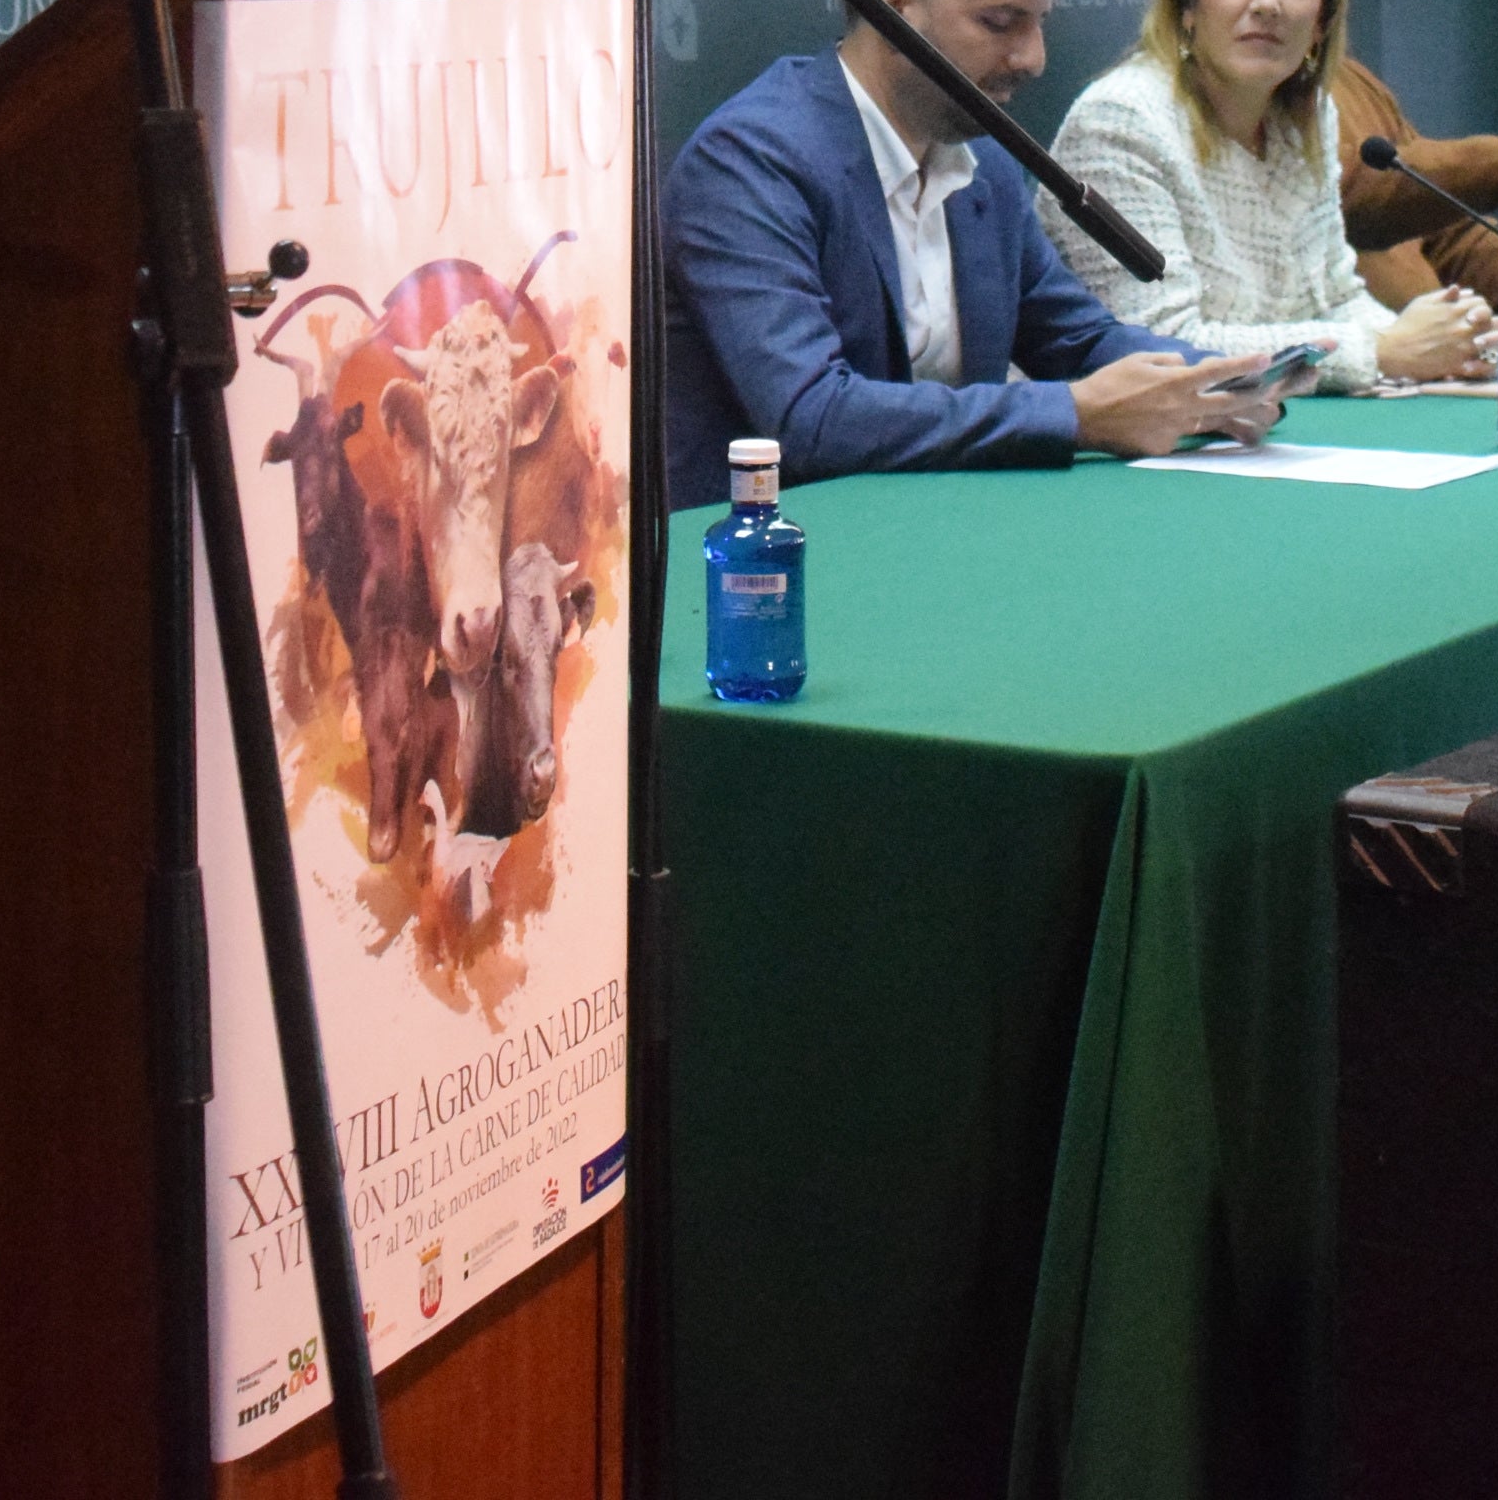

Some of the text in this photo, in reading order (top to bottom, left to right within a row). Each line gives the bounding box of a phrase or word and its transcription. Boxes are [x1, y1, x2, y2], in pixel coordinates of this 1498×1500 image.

[252, 49, 623, 234] TRUJILLO
[229, 978, 625, 1240] XXVIII AGROGANADER
[250, 1246, 268, 1291] Y
[394, 1158, 424, 1210] DE
[430, 1139, 454, 1188] LA
[460, 1100, 522, 1167] CARNE
[527, 1079, 552, 1127] DE
[557, 1033, 625, 1107] CALIDAD
[364, 1233, 381, 1269] 17
[386, 1222, 399, 1257] al
[405, 1211, 423, 1245] 20
[428, 1198, 445, 1230] de
[450, 1154, 522, 1214] noviembre
[526, 1137, 542, 1167] de
[546, 1111, 578, 1155] 2022
[238, 1382, 288, 1427] mrgt
